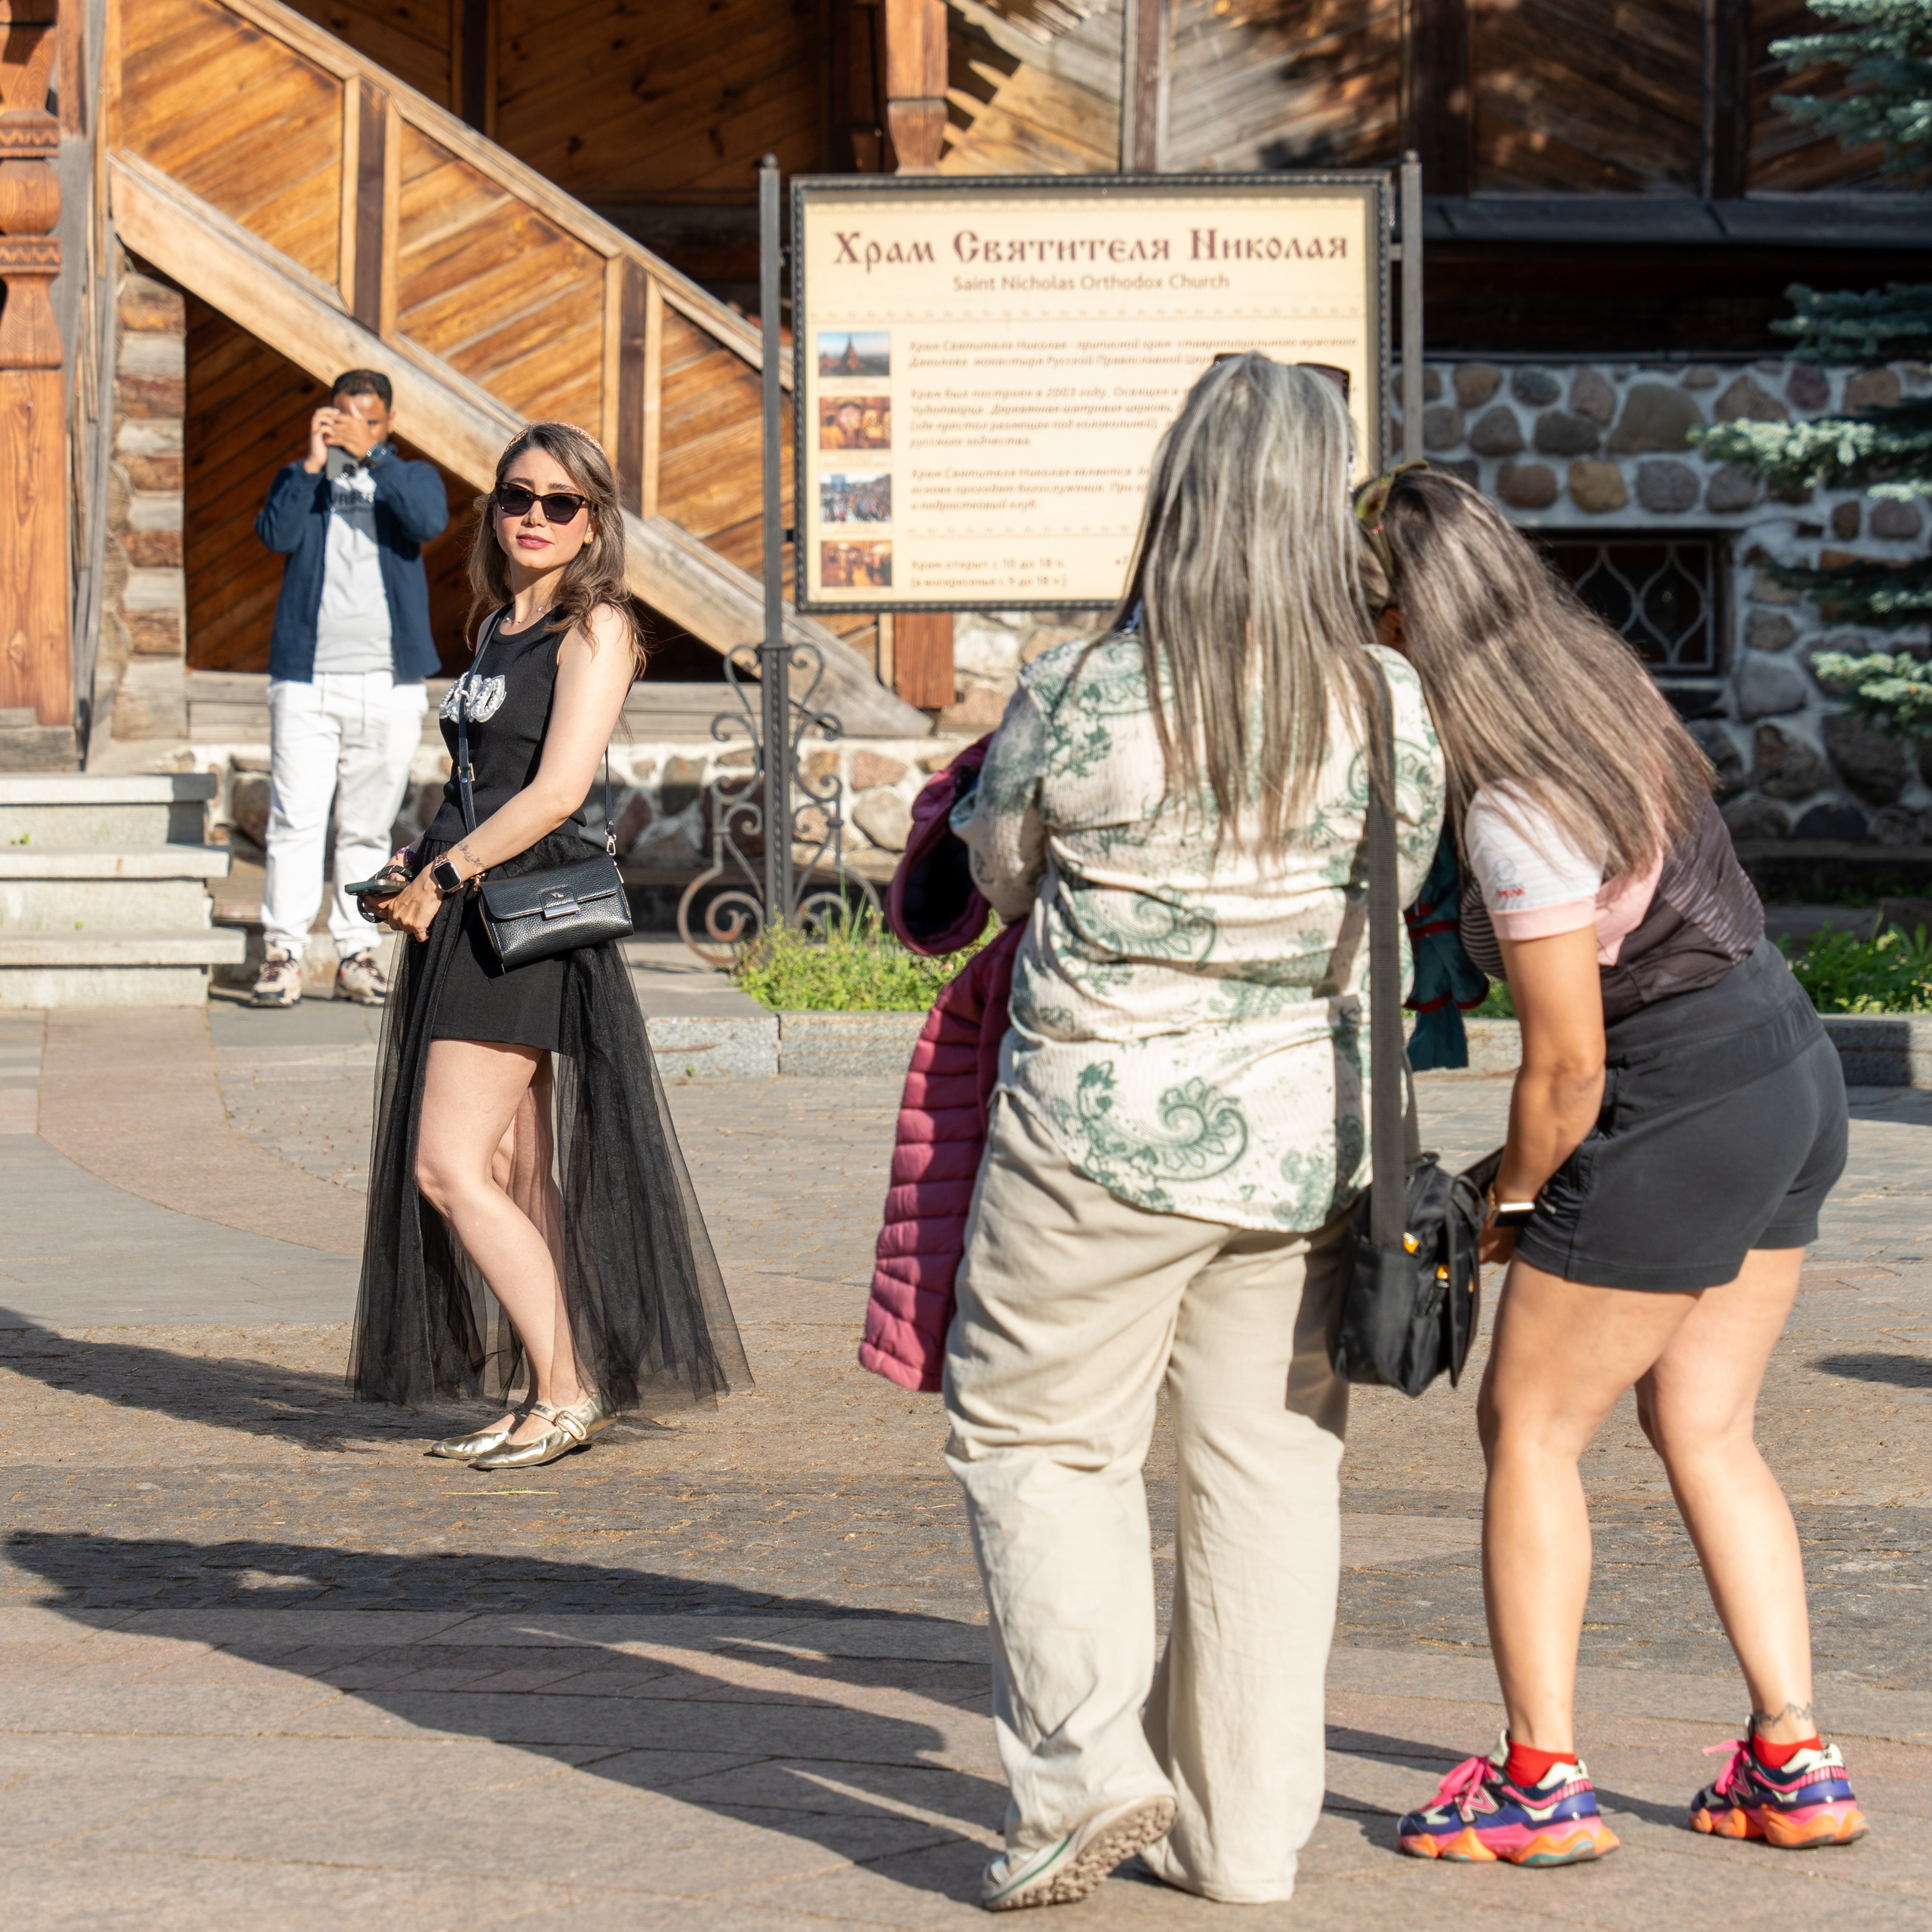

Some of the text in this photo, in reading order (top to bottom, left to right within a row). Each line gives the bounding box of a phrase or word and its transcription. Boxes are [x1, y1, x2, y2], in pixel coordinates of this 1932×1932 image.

[832, 227, 1347, 274] Храм Святителя Николая
[953, 272, 1229, 292] Saint Nicholas Orthodox Church
[909, 557, 942, 572] Храм
